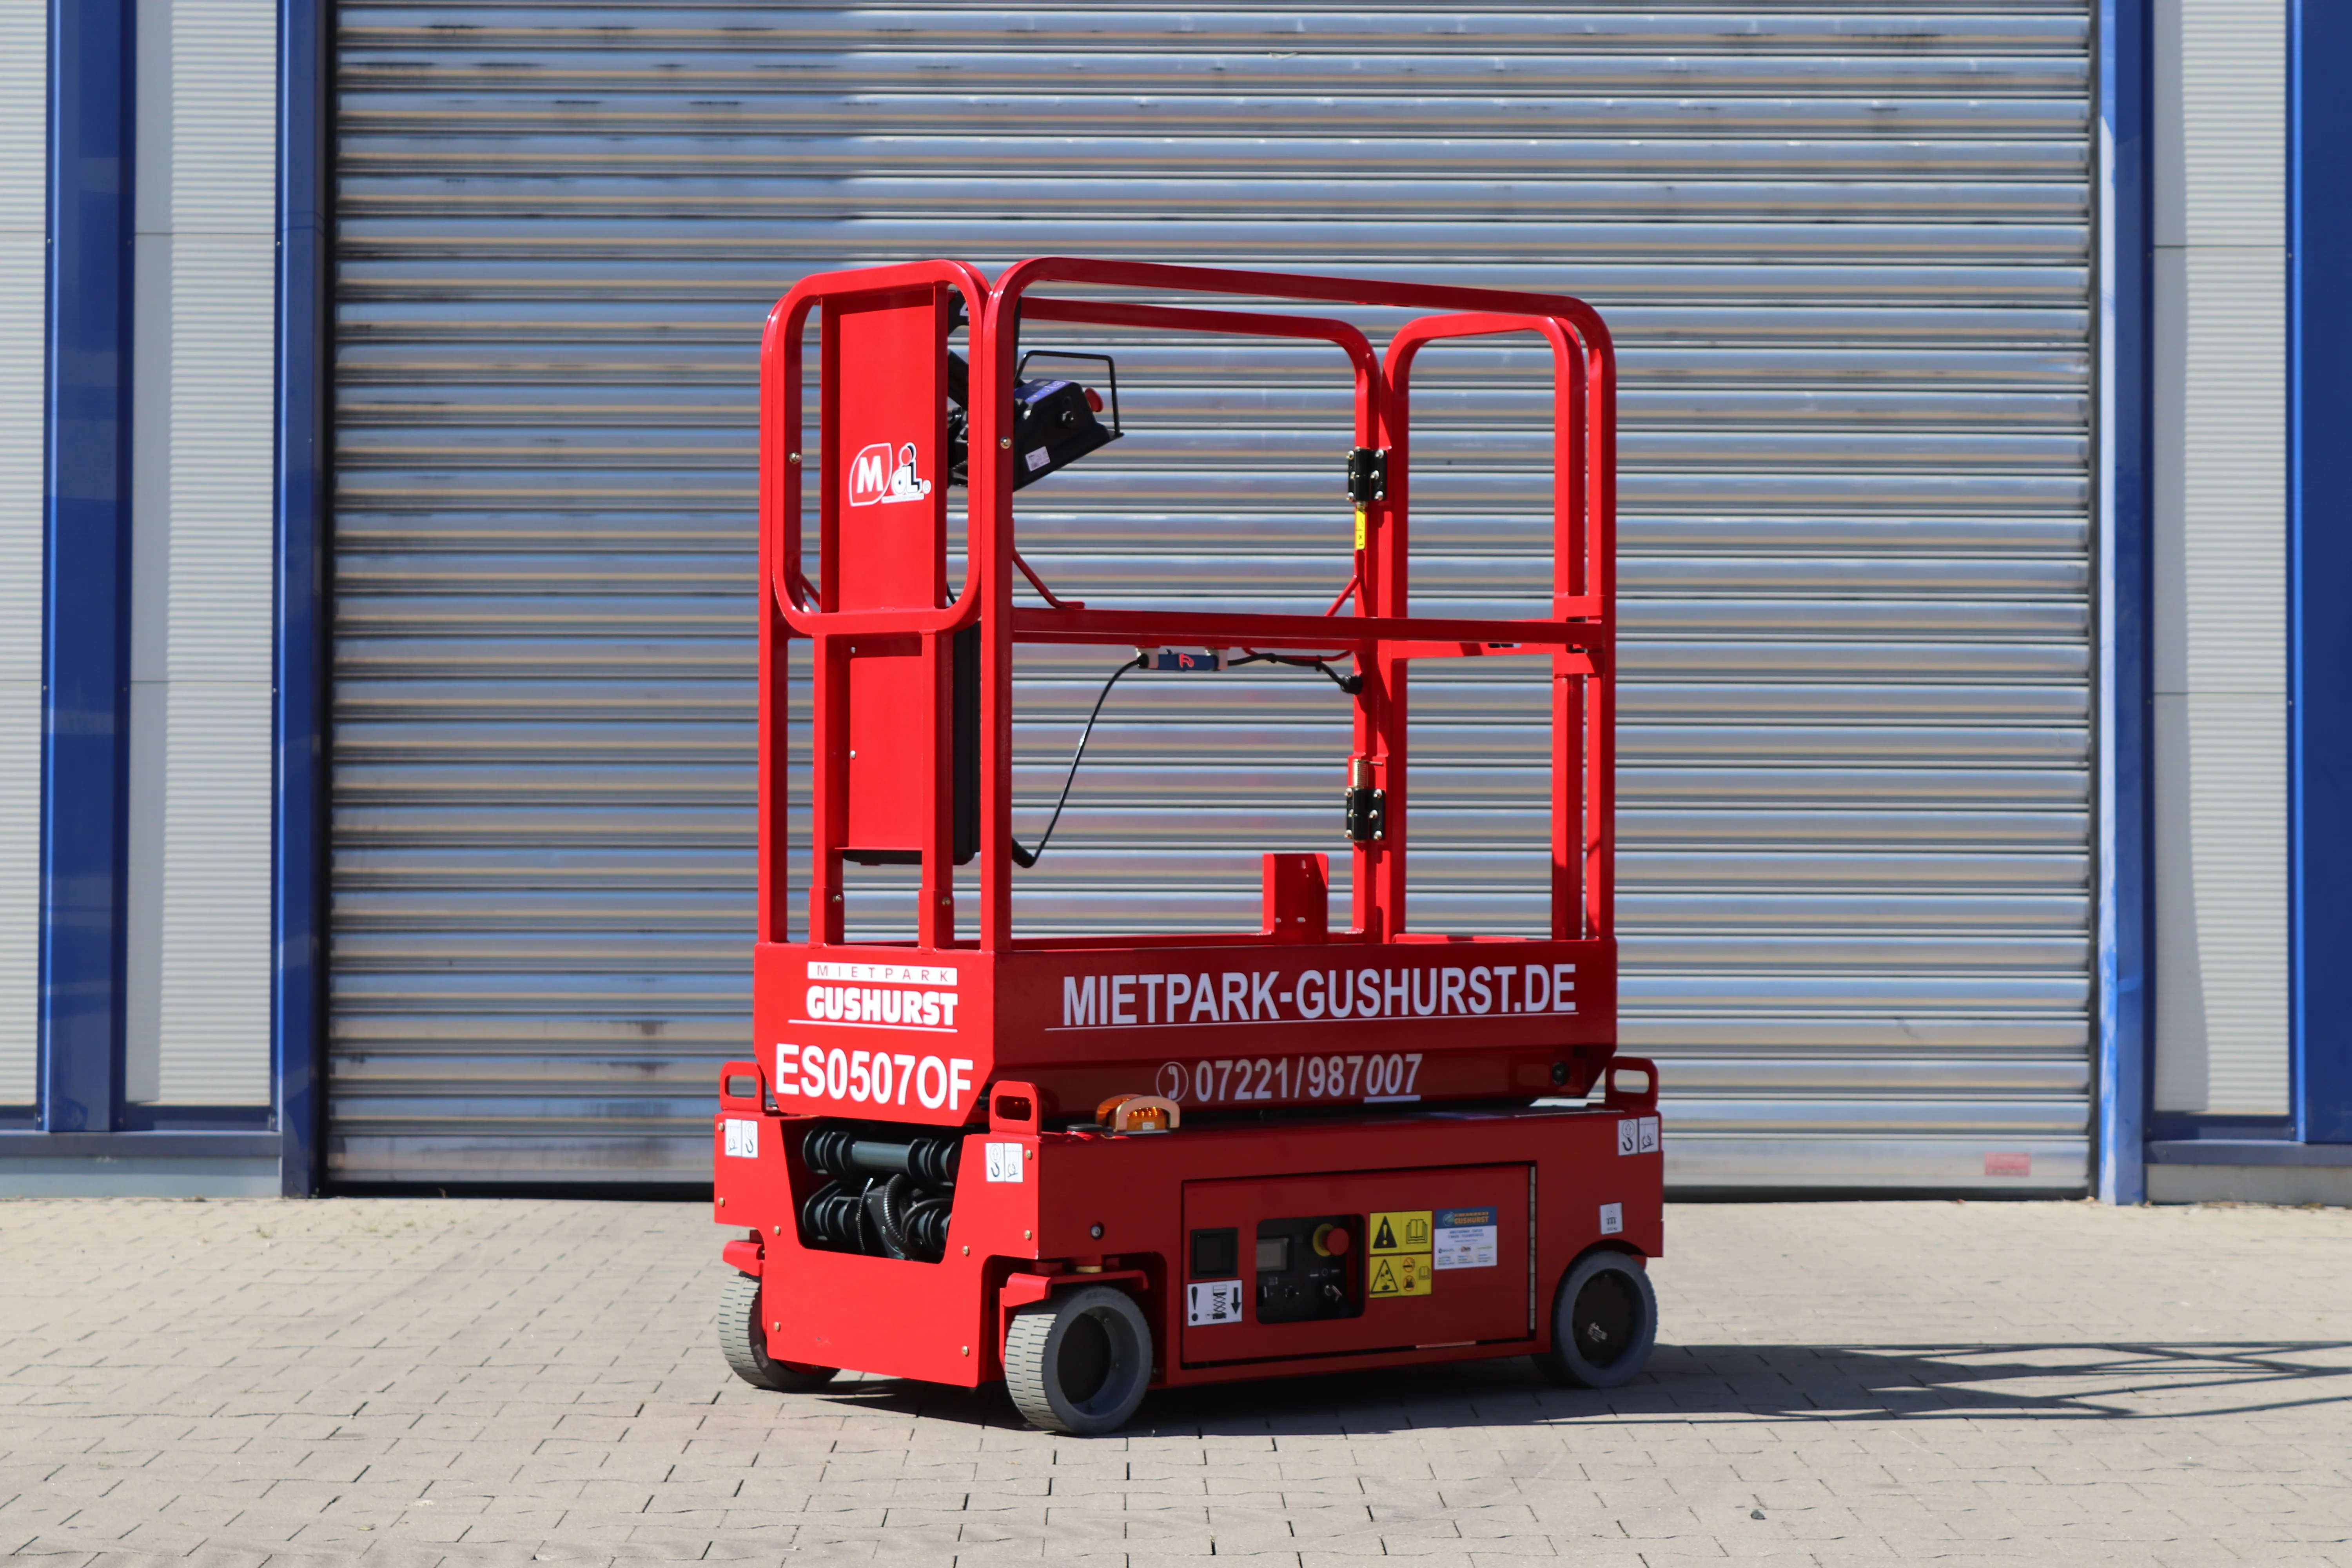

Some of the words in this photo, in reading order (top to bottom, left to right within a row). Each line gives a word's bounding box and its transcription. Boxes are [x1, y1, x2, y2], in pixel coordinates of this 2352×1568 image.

[817, 965, 948, 982] MIETPARK
[806, 985, 958, 1025] GUSHURST
[1063, 964, 1576, 1026] MIETPARK-GUSHURST.DE
[1196, 1054, 1422, 1102] 07221/987007
[1454, 1216, 1489, 1224] GUSHURST
